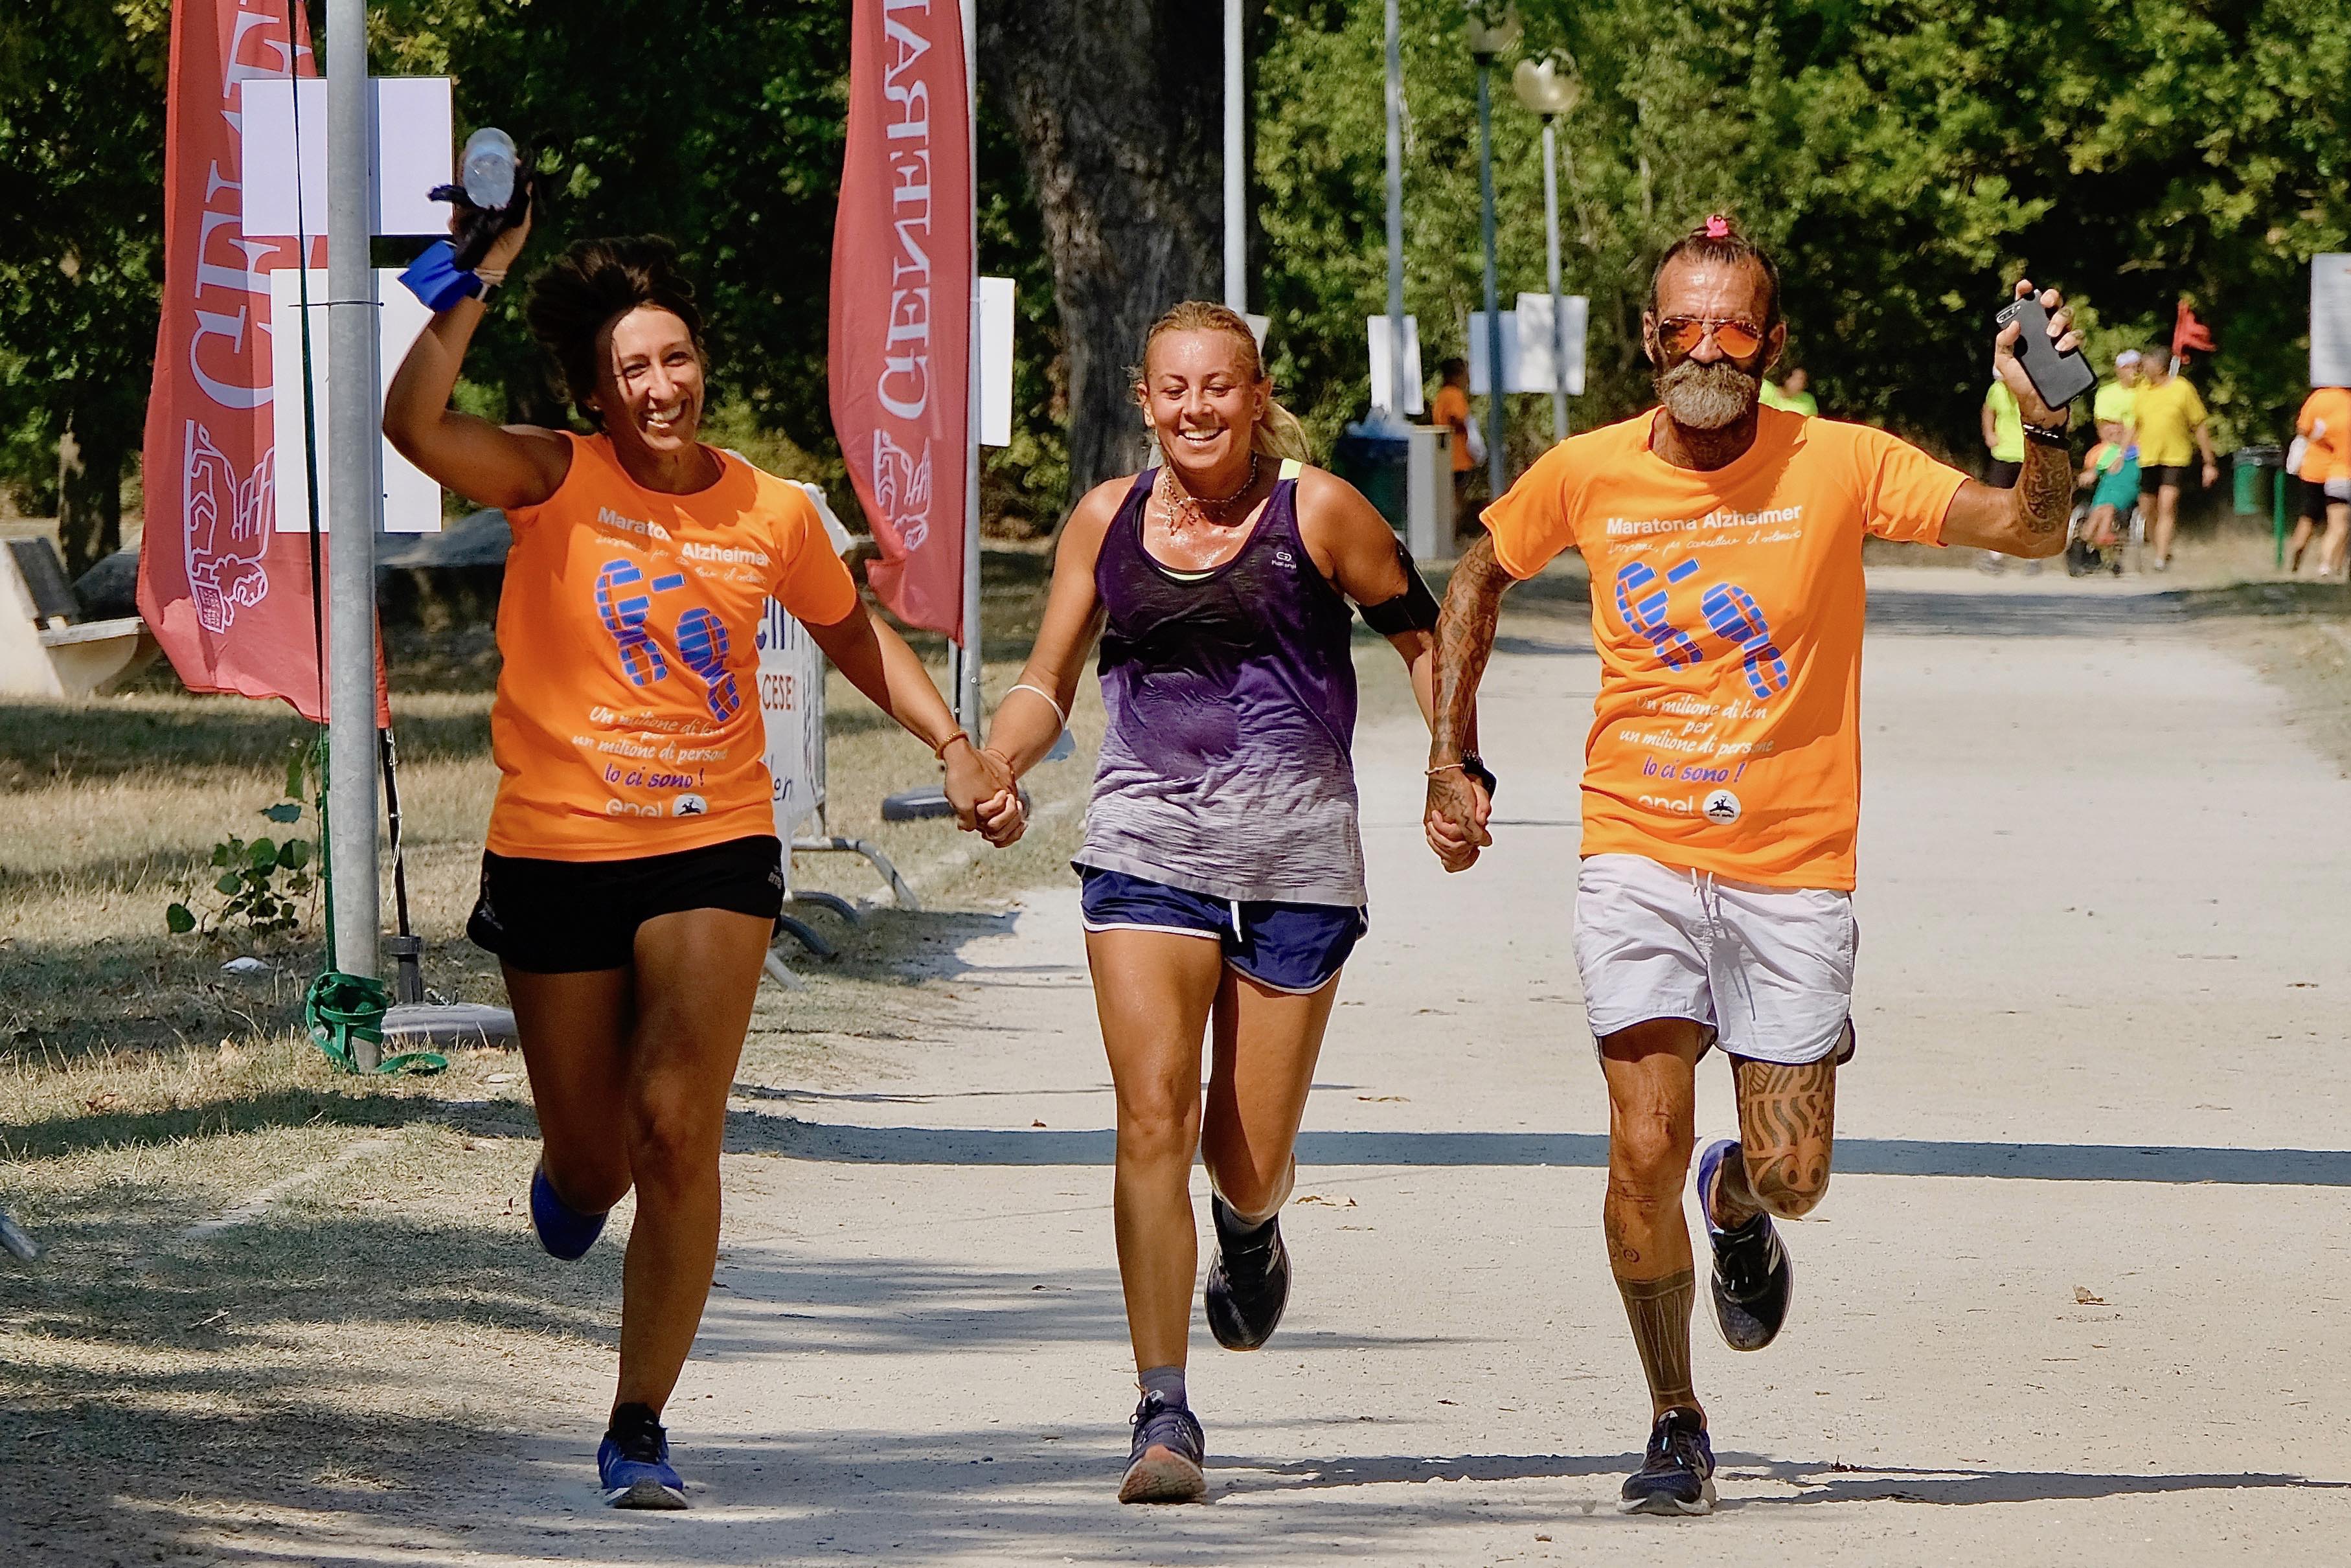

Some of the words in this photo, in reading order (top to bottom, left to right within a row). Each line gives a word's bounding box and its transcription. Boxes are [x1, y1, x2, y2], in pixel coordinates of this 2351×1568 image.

[1606, 517, 1697, 534] Maratona
[1703, 505, 1803, 529] Alzheimer
[597, 506, 673, 541] Marato
[681, 541, 769, 567] Alzheime
[1637, 696, 1656, 710] Un
[1661, 694, 1720, 716] milione
[1721, 698, 1741, 719] di
[1742, 699, 1767, 719] km
[589, 706, 615, 725] Un
[679, 718, 700, 736] di
[1681, 720, 1713, 736] per
[598, 738, 655, 760] milione
[658, 740, 675, 760] di
[1620, 730, 1641, 742] un
[1642, 729, 1696, 753] milione
[1698, 734, 1718, 753] di
[1715, 740, 1774, 758] persone
[624, 766, 646, 787] ci
[647, 773, 694, 789] sono
[1661, 758, 1680, 778] ci
[1681, 765, 1730, 782] sono
